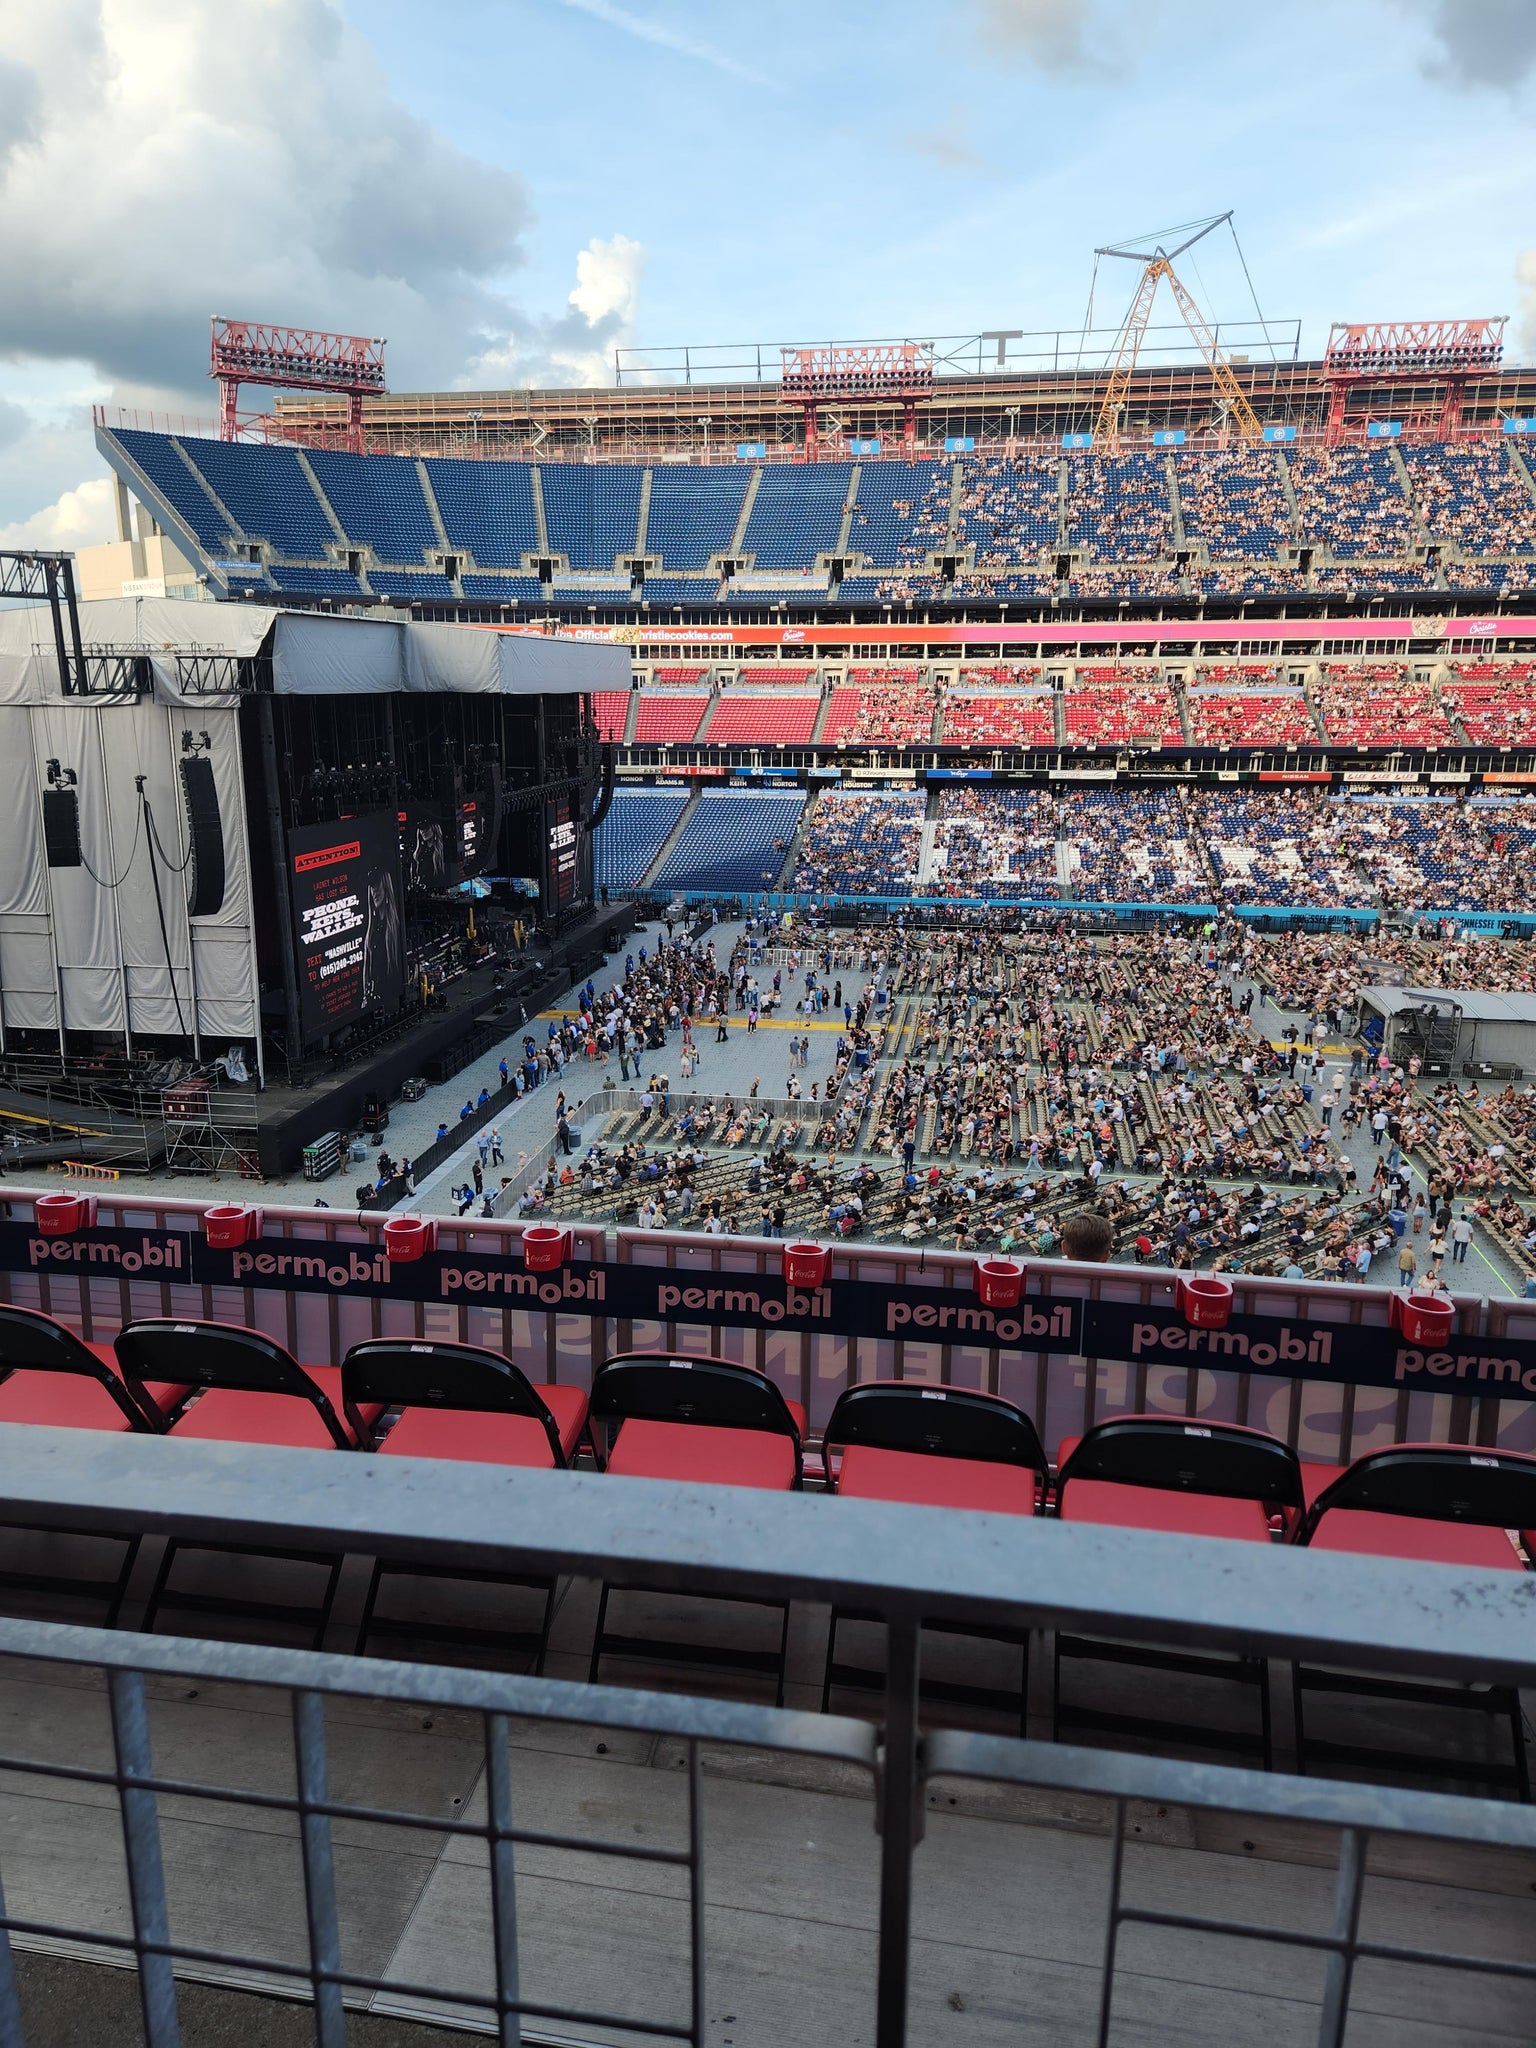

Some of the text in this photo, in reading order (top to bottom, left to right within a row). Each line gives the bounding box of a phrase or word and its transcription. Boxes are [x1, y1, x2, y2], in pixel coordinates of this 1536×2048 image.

[575, 629, 613, 640] Official
[296, 846, 359, 868] ATTENTION!
[302, 894, 360, 923] PHONE,
[310, 907, 354, 931] KEYS,
[301, 913, 364, 945] WALLET
[306, 953, 322, 968] TEXT
[308, 970, 317, 982] TO
[1391, 1176, 1399, 1185] A
[29, 1237, 182, 1272] permobil
[233, 1250, 391, 1287] permobil
[440, 1267, 606, 1304] permobil
[658, 1284, 832, 1322] permobil
[886, 1300, 1073, 1341] permobil
[1131, 1321, 1333, 1367] permobil
